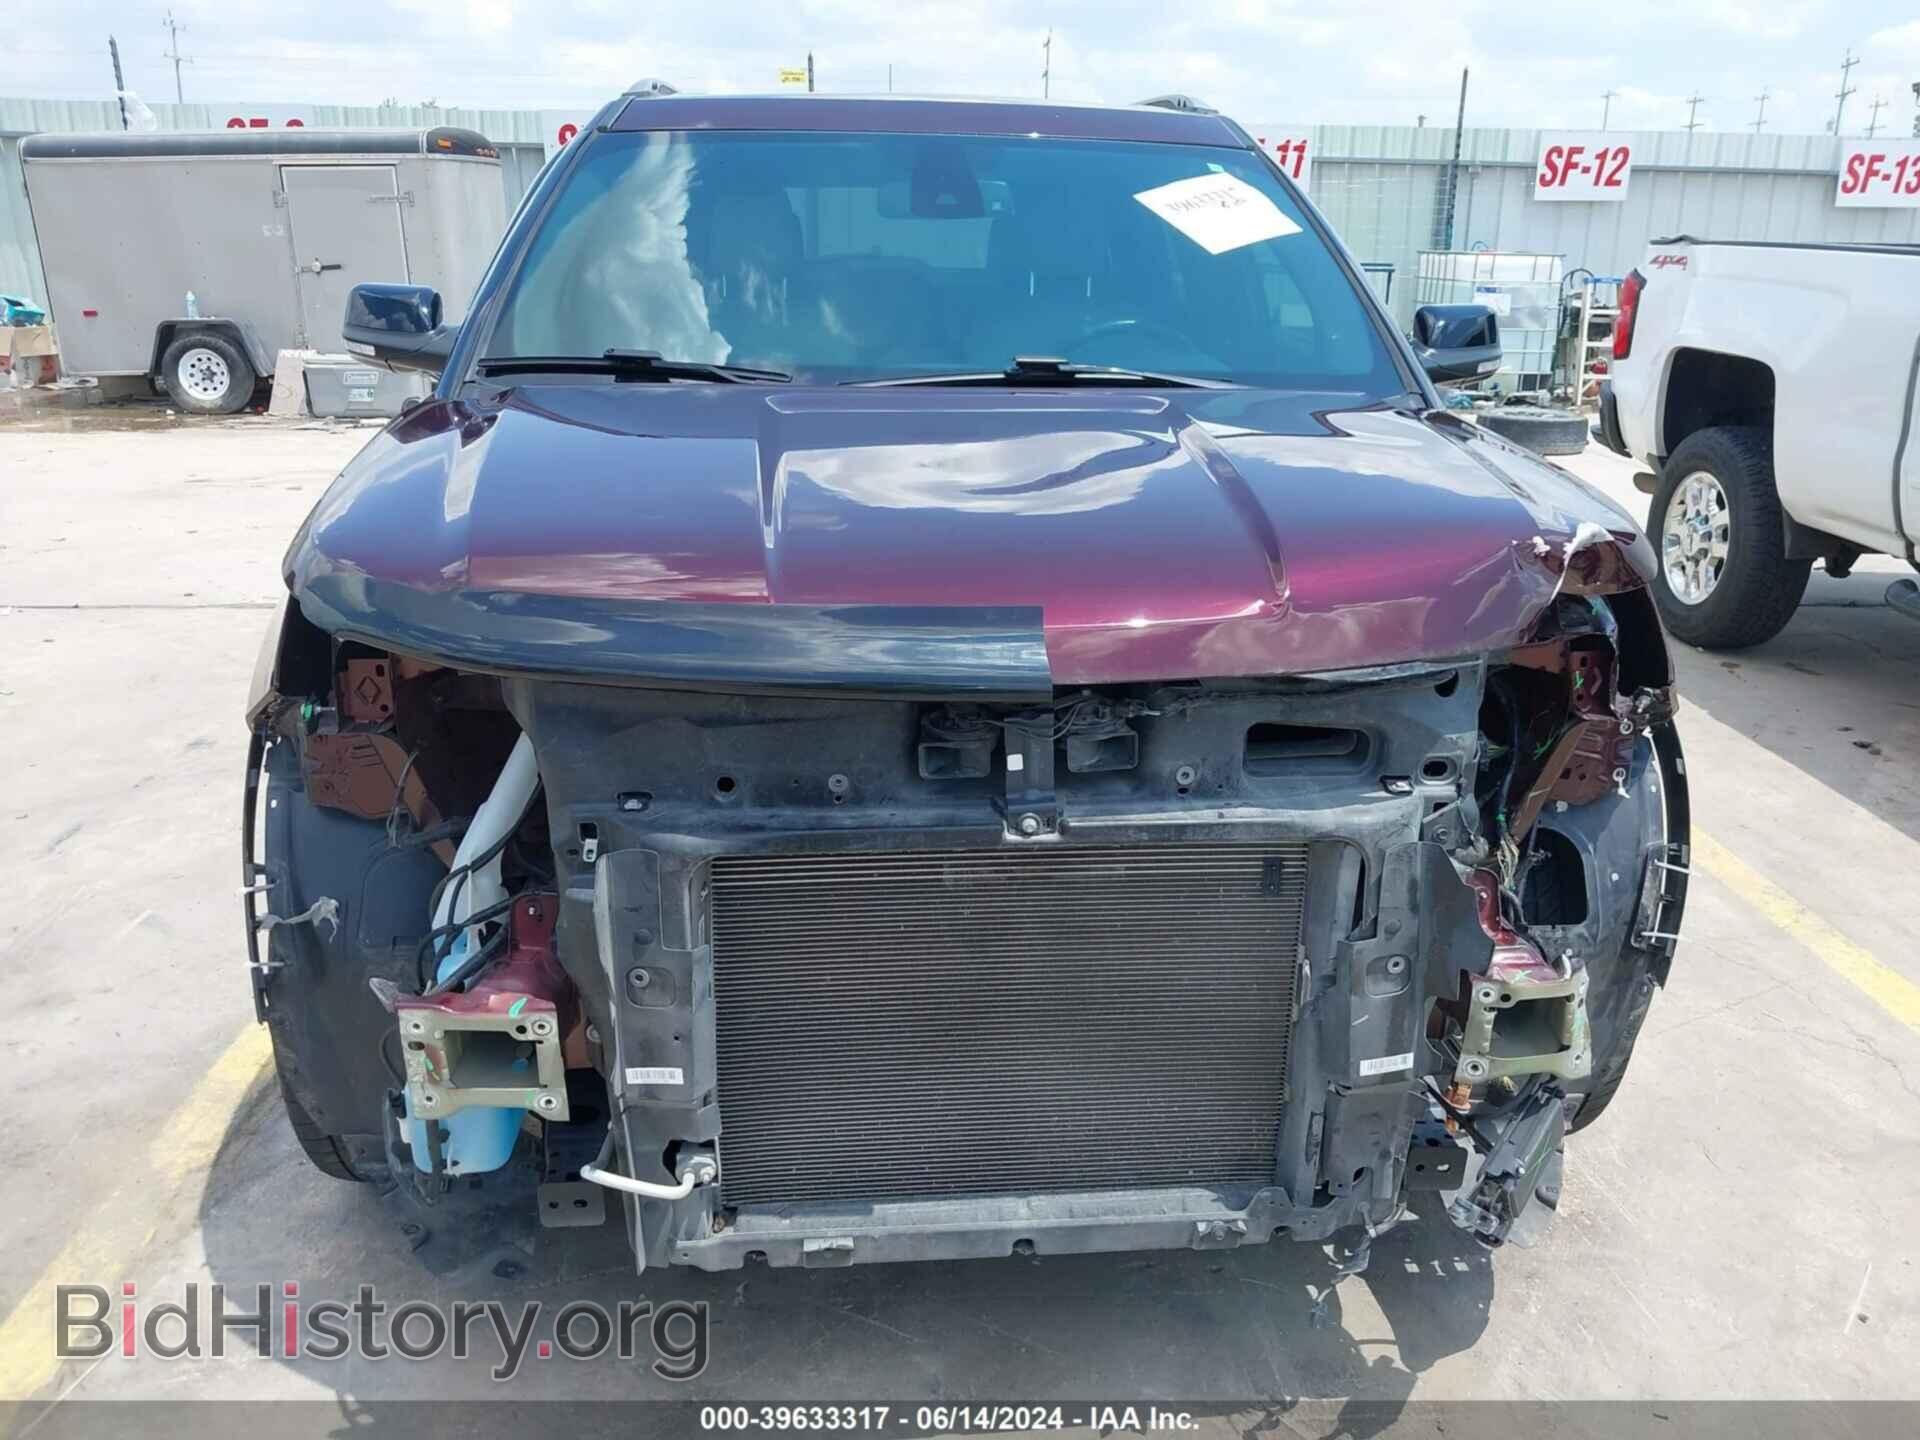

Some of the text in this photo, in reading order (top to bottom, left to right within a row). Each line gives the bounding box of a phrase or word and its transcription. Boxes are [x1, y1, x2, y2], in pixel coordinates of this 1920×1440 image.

[1258, 138, 1307, 178] 11
[1539, 146, 1630, 187] SF-12
[1841, 153, 1920, 194] SF-13
